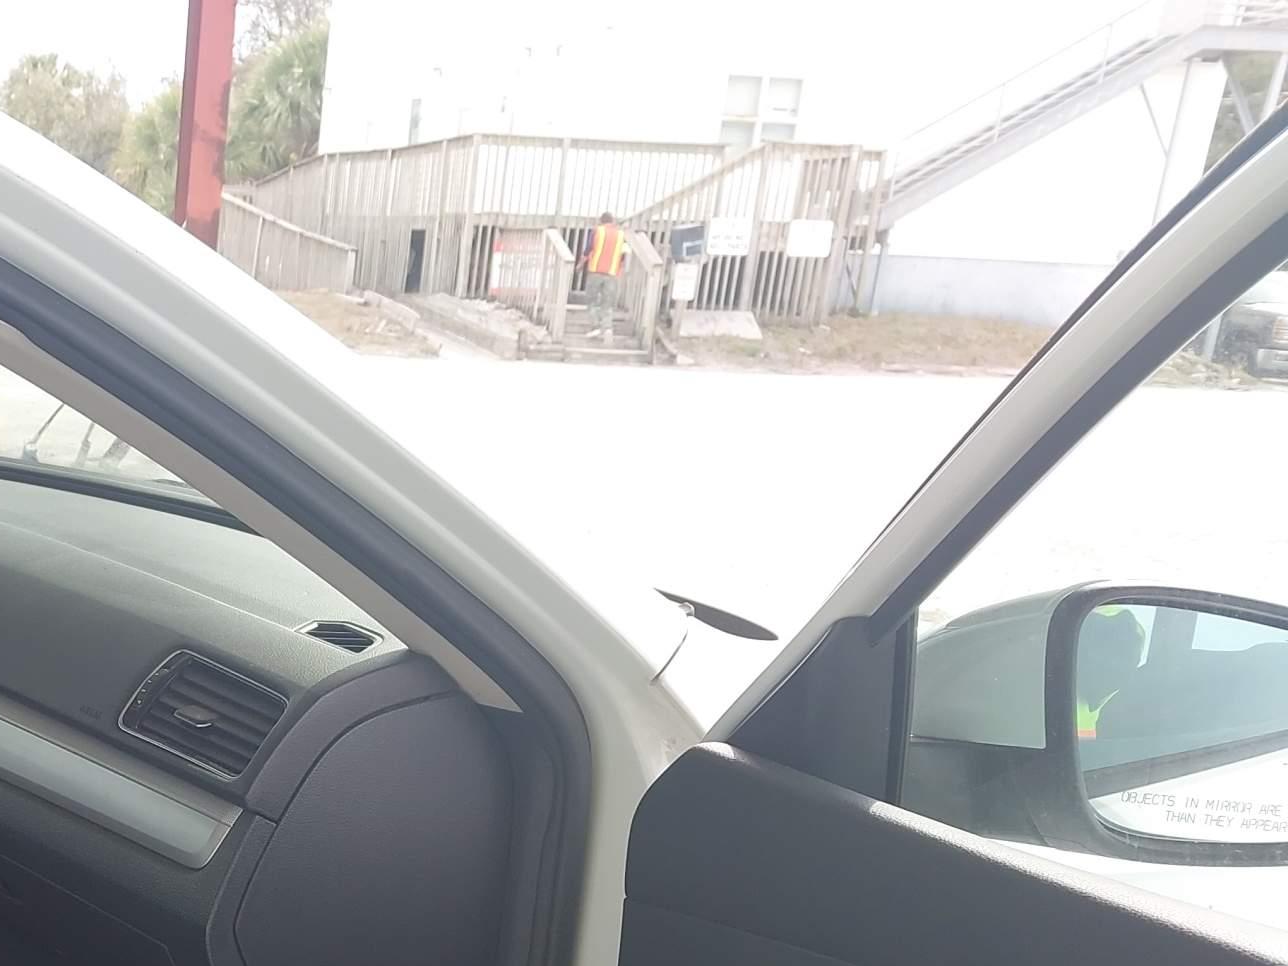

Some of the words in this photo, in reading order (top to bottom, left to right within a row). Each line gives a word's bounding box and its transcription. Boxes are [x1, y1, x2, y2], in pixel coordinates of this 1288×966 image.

[1120, 791, 1176, 807] OBJECTS
[1185, 797, 1199, 809] IN
[1205, 799, 1253, 814] MIRROR
[1259, 804, 1283, 817] ARE
[1165, 810, 1196, 823] THAN
[1203, 813, 1235, 827] THEY
